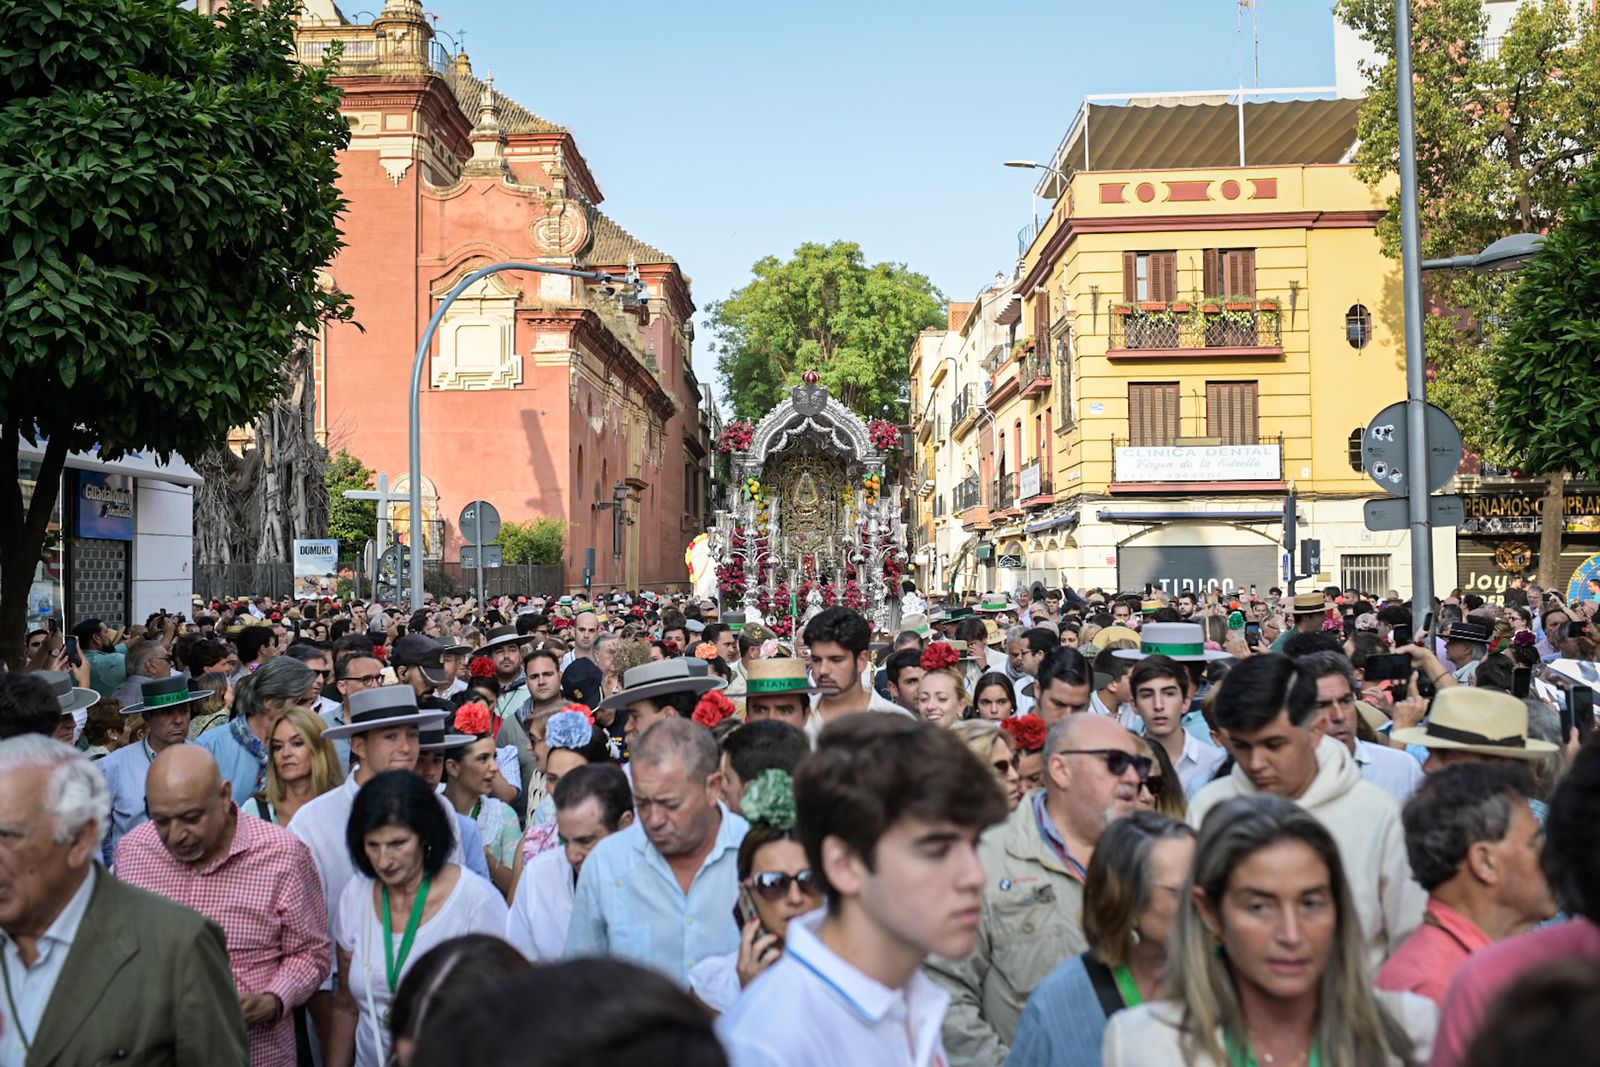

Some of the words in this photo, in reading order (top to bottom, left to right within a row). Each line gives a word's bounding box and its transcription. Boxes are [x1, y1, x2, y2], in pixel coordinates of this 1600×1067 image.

[1122, 447, 1197, 457] CLINICA
[1205, 447, 1273, 457] DENTAL
[1136, 458, 1174, 471] Virgen
[1180, 459, 1193, 469] de
[1199, 458, 1211, 469] la
[1216, 457, 1262, 468] Estrella
[1464, 496, 1530, 516] PEÑAMOS
[300, 545, 332, 555] DOMUND
